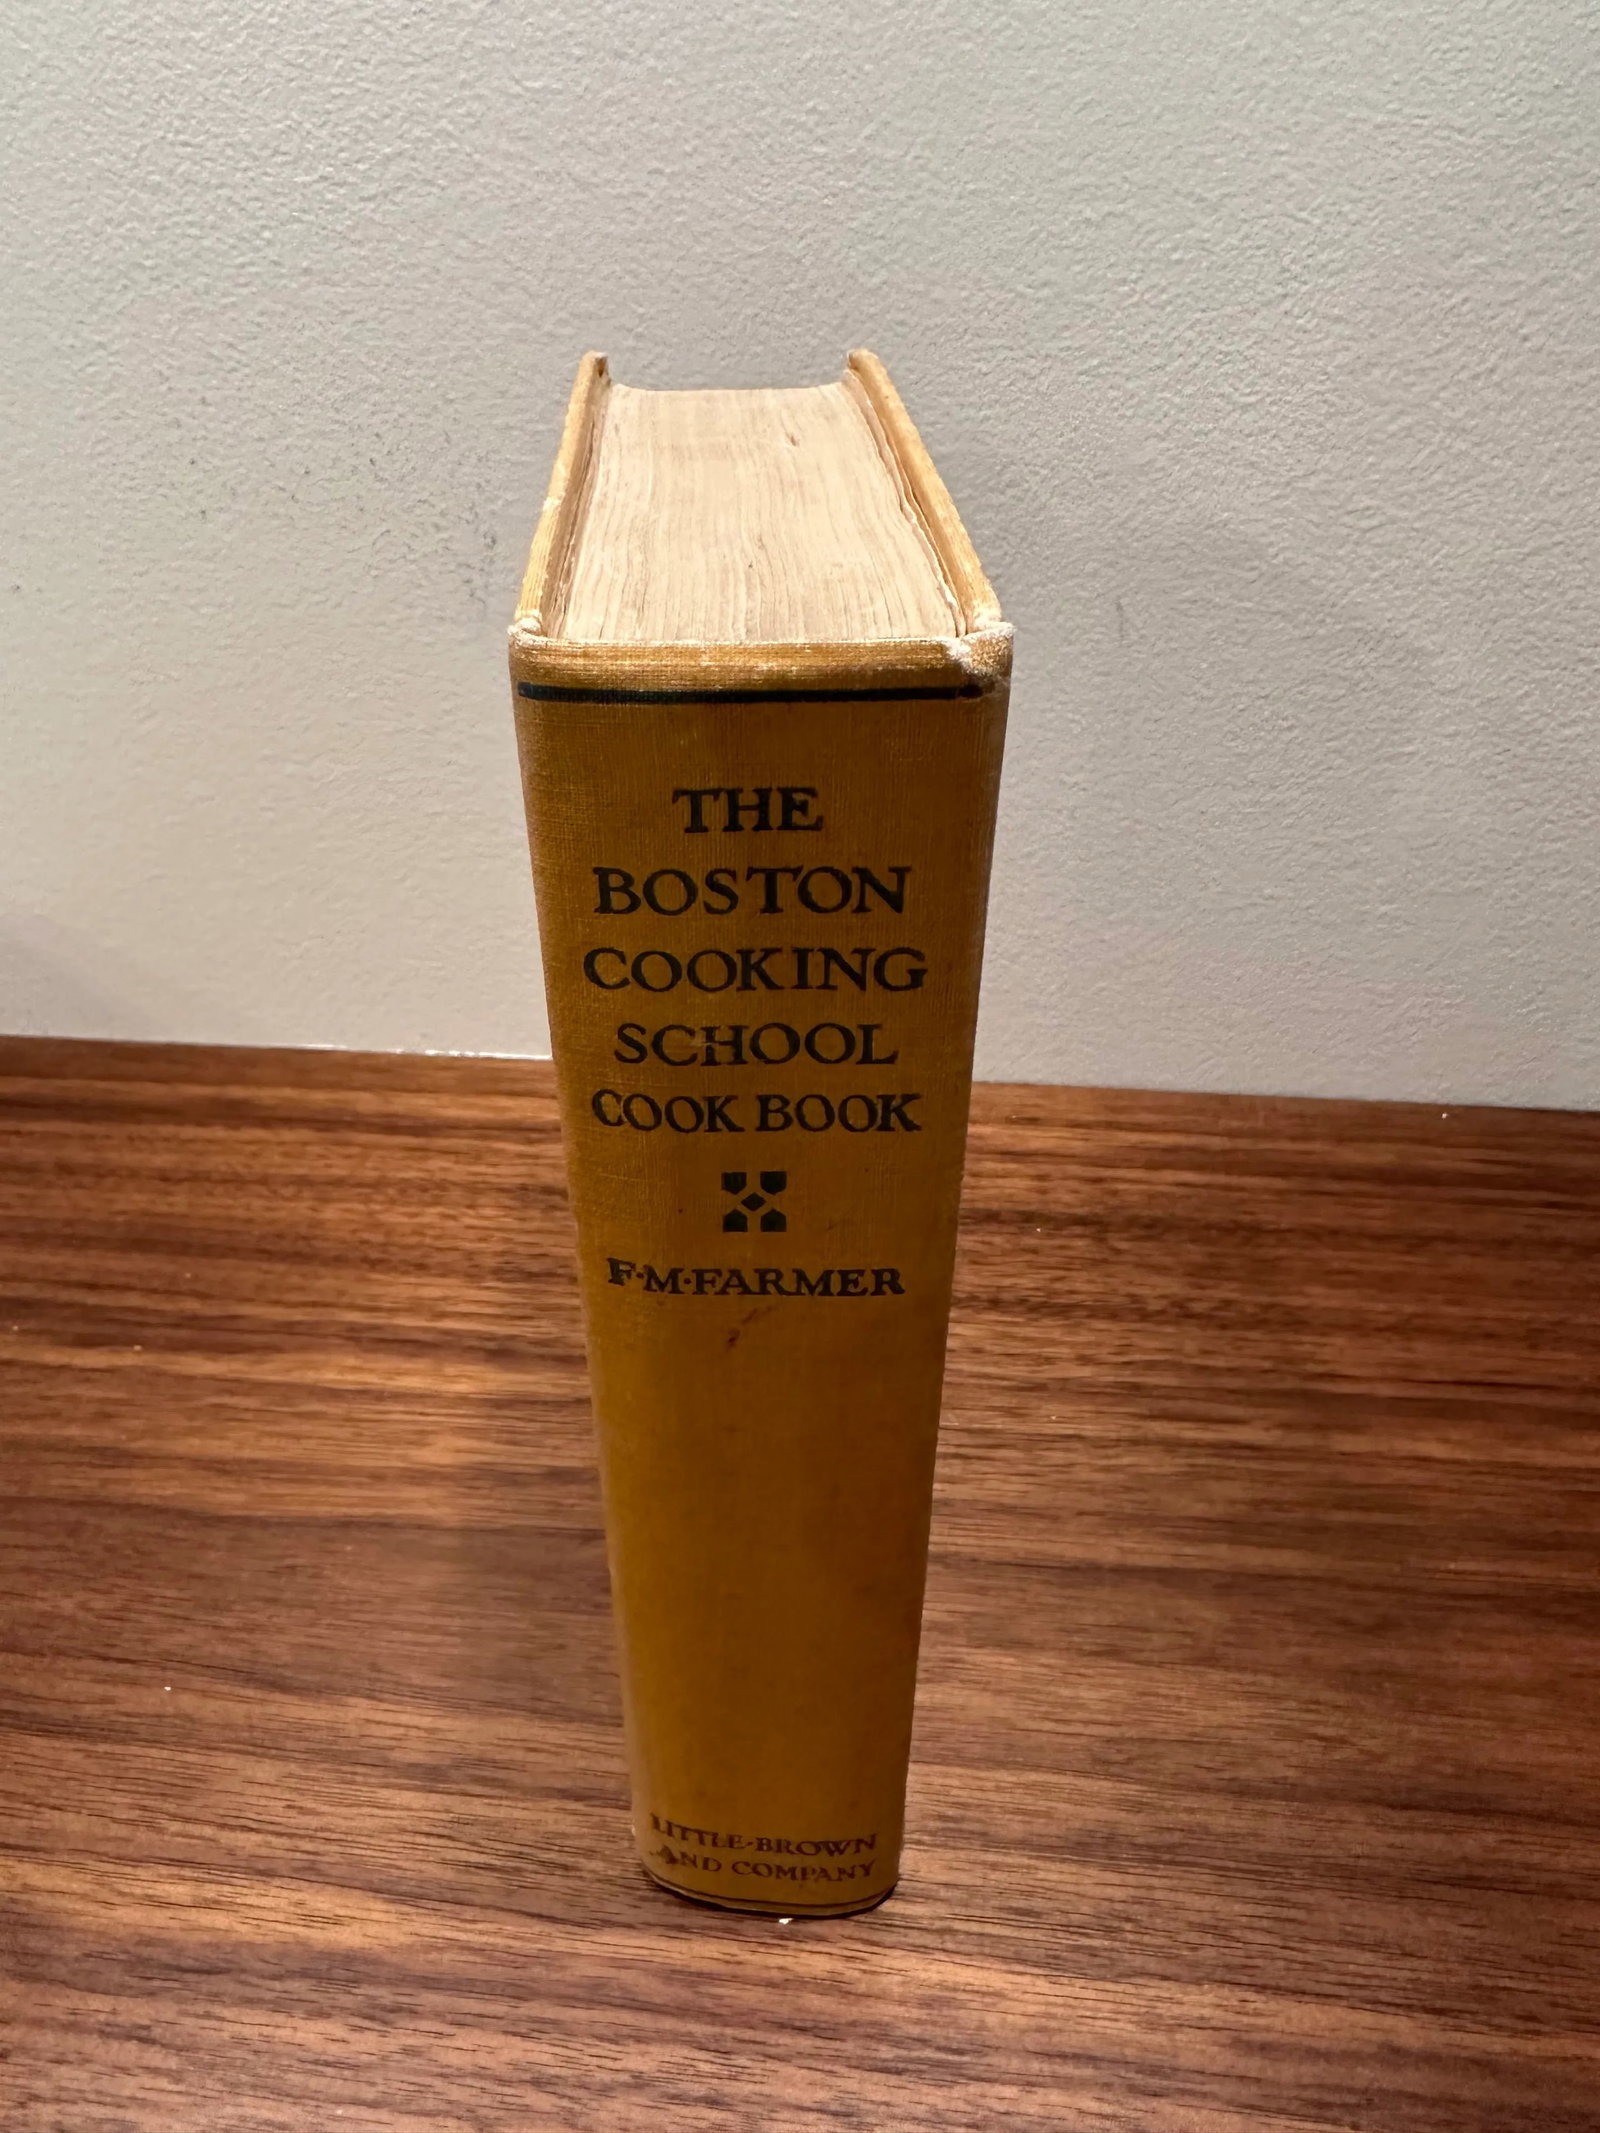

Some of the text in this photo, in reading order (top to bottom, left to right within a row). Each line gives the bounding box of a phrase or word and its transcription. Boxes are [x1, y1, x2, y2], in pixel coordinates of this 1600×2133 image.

[672, 786, 823, 833] THE
[592, 866, 912, 915] BOSTON
[583, 947, 928, 992] COOKING
[614, 1023, 899, 1066] SCHOOL
[591, 1089, 922, 1133] COOK BOOK
[652, 1844, 877, 1882] AND COMPANY
